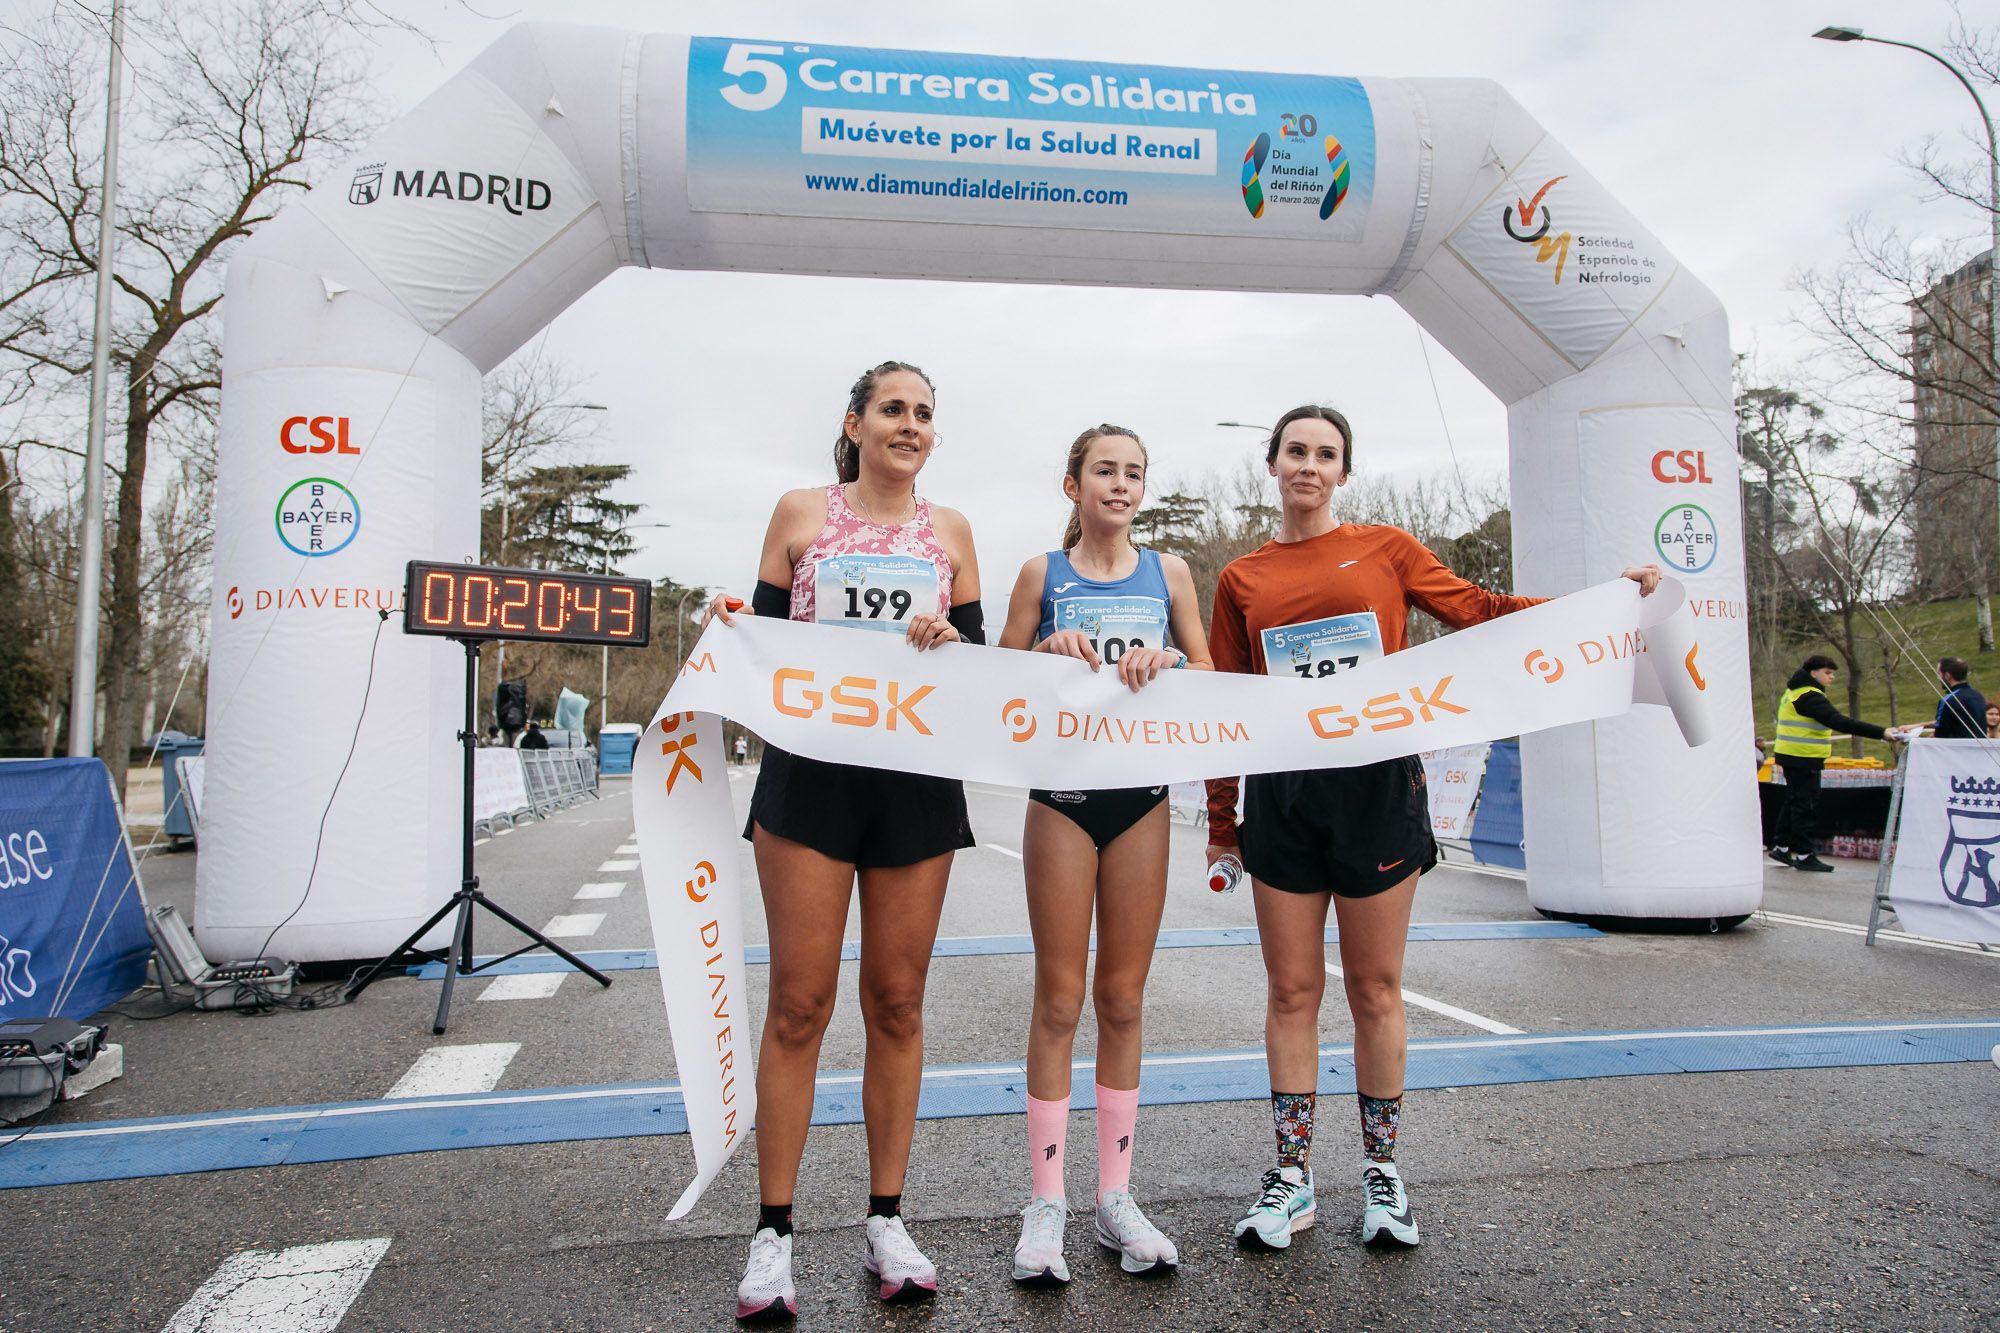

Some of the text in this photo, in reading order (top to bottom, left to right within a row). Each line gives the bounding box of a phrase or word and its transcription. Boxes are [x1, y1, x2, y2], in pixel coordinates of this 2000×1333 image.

[799, 58, 1010, 102] Carrera
[1028, 71, 1257, 116] Solidaria
[820, 118, 1200, 160] Muévete por la Salud Renal
[1280, 113, 1318, 138] 20
[1272, 149, 1291, 160] Día
[1272, 165, 1318, 177] Mundial
[393, 170, 551, 216] MADRID
[805, 173, 1128, 206] www.diamundialdelriñon.com
[1270, 181, 1324, 192] del Riñón
[1270, 195, 1278, 203] 12
[1303, 197, 1321, 205] 2026
[1578, 236, 1634, 250] Sociedad
[1579, 255, 1656, 269] Española de
[280, 416, 361, 455] CSL
[1651, 450, 1712, 484] CSL
[283, 511, 352, 524] BAYER
[310, 485, 324, 550] BAYER
[1661, 533, 1713, 544] BAYER
[1683, 510, 1696, 567] BAYER
[424, 573, 635, 636] 00:20:43
[845, 587, 912, 620] 199
[1078, 606, 1112, 614] Carrera
[1114, 605, 1151, 614] Solidaria
[1287, 630, 1320, 643] Carrera
[1321, 624, 1359, 636] Solidaria
[772, 666, 937, 736] GSK
[1307, 675, 1471, 740] GSK
[1058, 710, 1250, 745] DIAVERUM
[1445, 770, 1468, 784] GSK
[700, 919, 738, 1150] DIAVERUM
